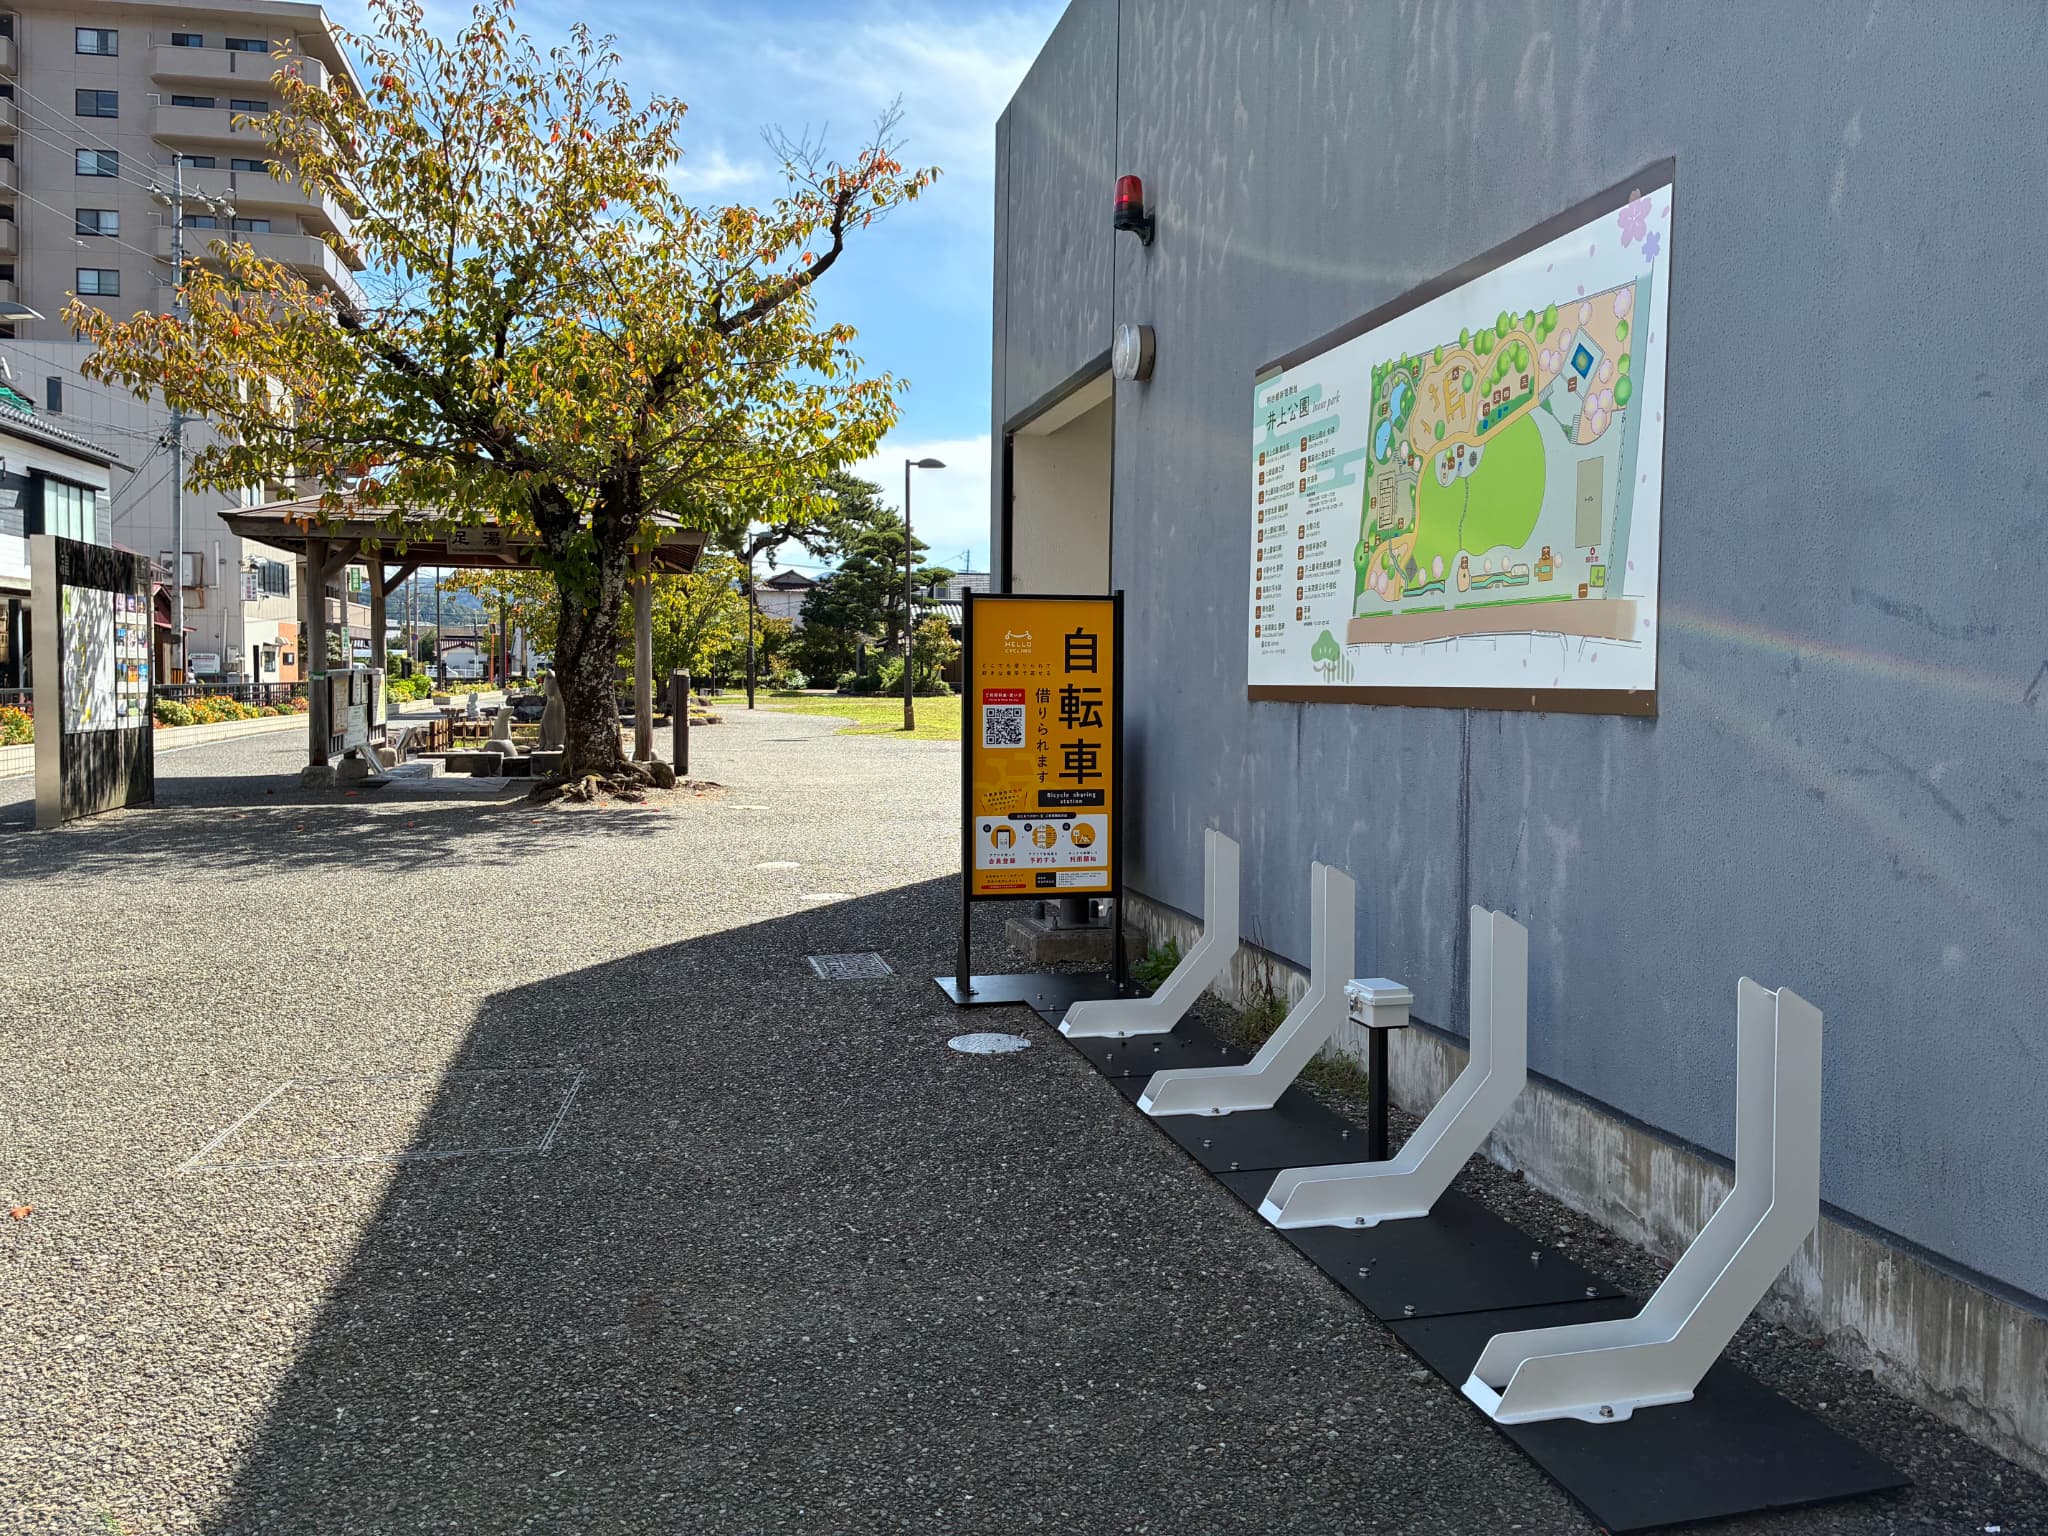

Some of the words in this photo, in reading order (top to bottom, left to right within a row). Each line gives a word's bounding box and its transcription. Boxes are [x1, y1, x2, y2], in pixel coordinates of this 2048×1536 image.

[1266, 396, 1309, 432] 井上公園
[452, 530, 501, 546] 足湯
[1058, 627, 1103, 785] 自転車
[1035, 687, 1050, 784] 借りられます
[1072, 791, 1097, 799] sharing
[988, 857, 1016, 865] 会員登録
[1029, 856, 1056, 864] 予約する
[1069, 855, 1097, 863] 利用開始
